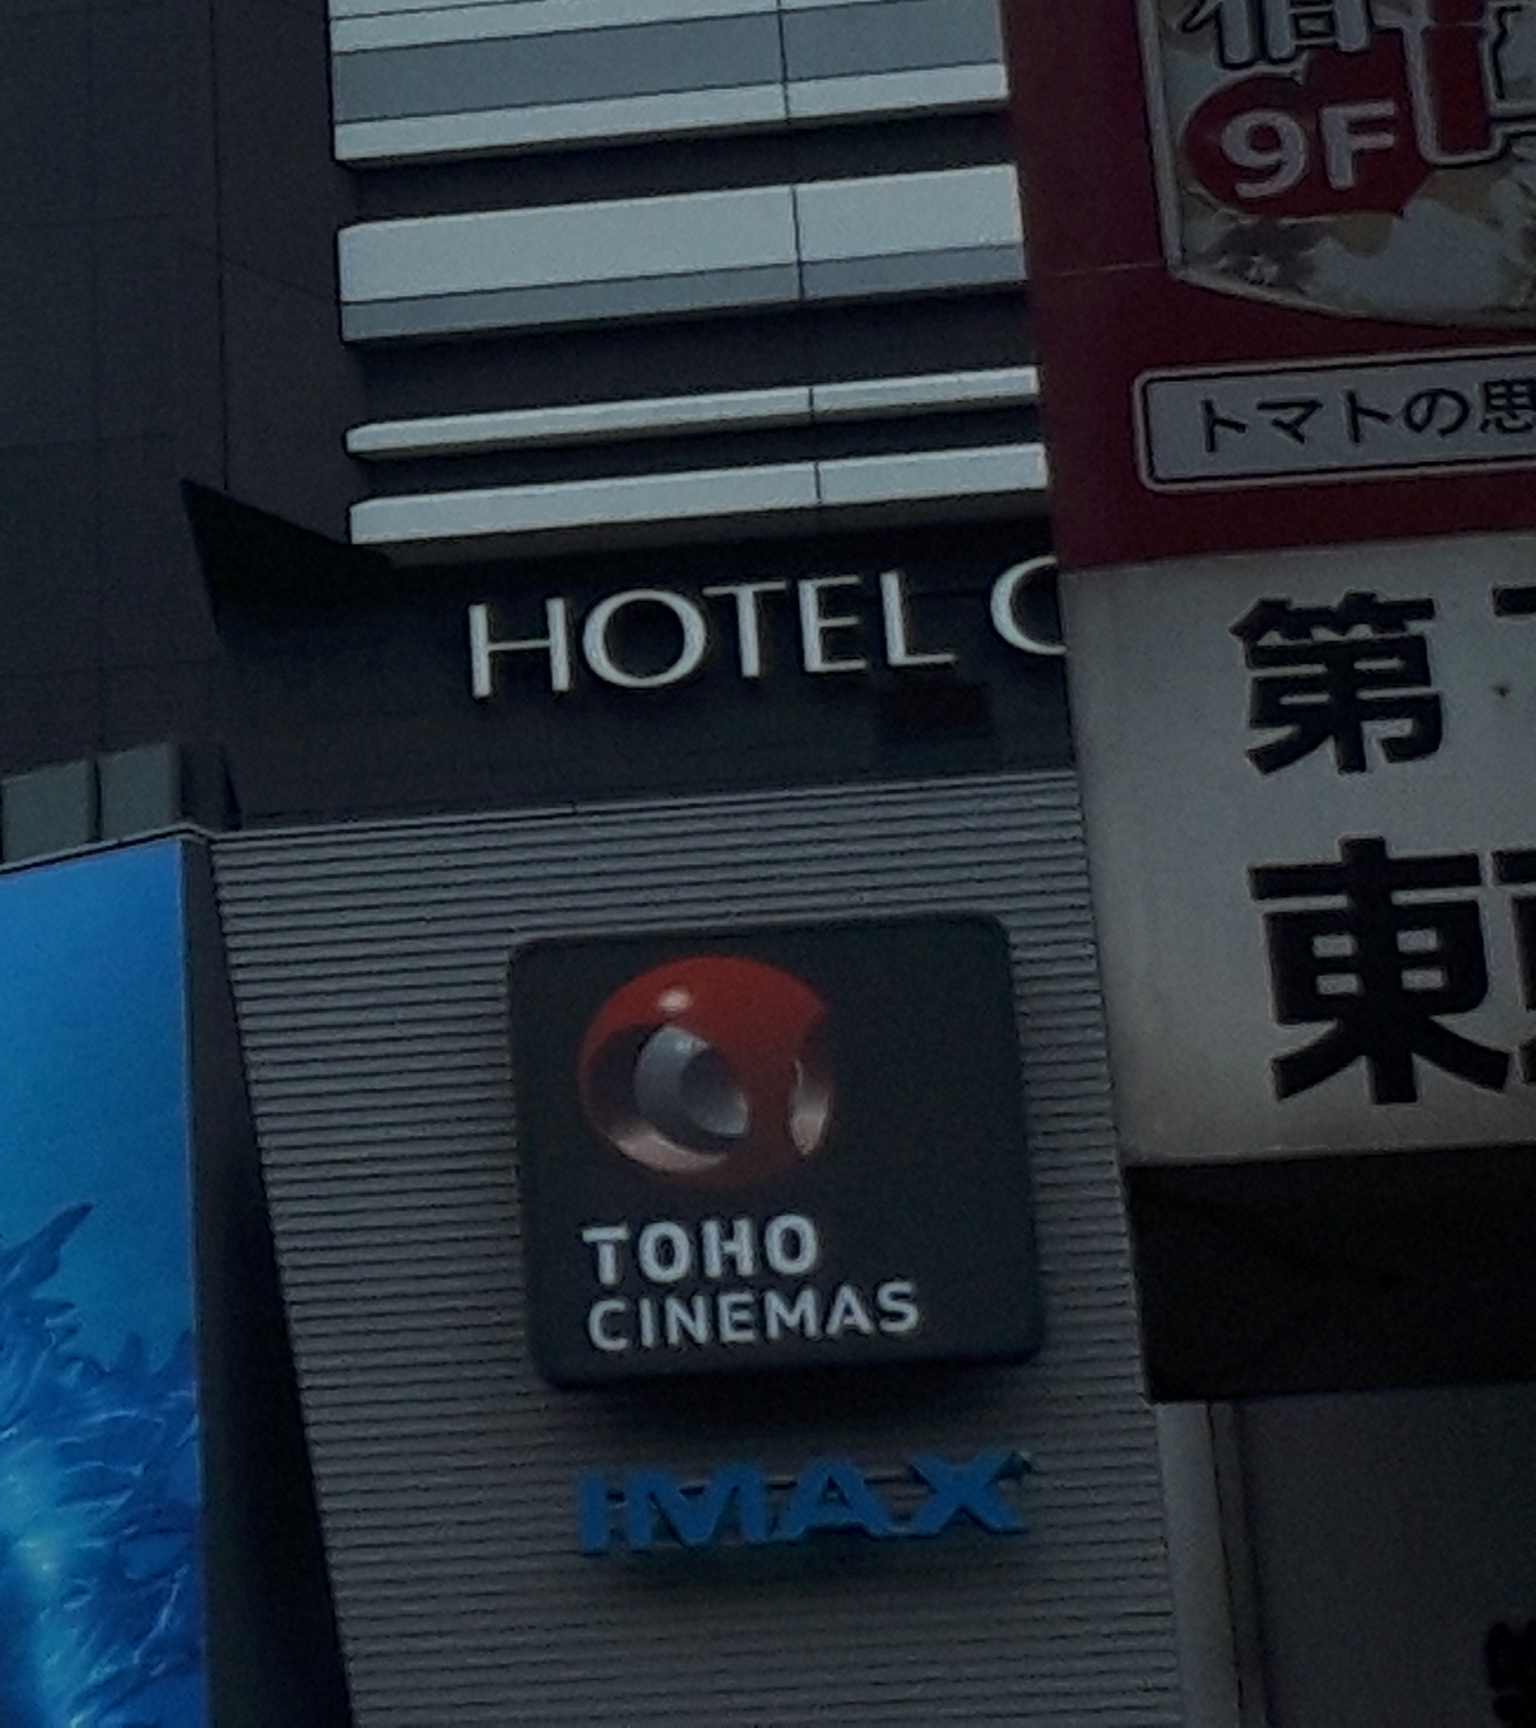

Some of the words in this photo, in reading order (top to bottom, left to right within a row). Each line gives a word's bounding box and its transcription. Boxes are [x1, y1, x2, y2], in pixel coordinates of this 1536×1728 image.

[1218, 100, 1400, 199] 9F
[1200, 379, 1536, 453] トマトの思
[467, 569, 957, 699] HOTEL
[1230, 584, 1536, 776] 第
[1248, 836, 1536, 1106] 東
[581, 1214, 819, 1284] TOHO
[586, 1281, 921, 1353] CINEMAS
[575, 1453, 1032, 1557] IMAX
